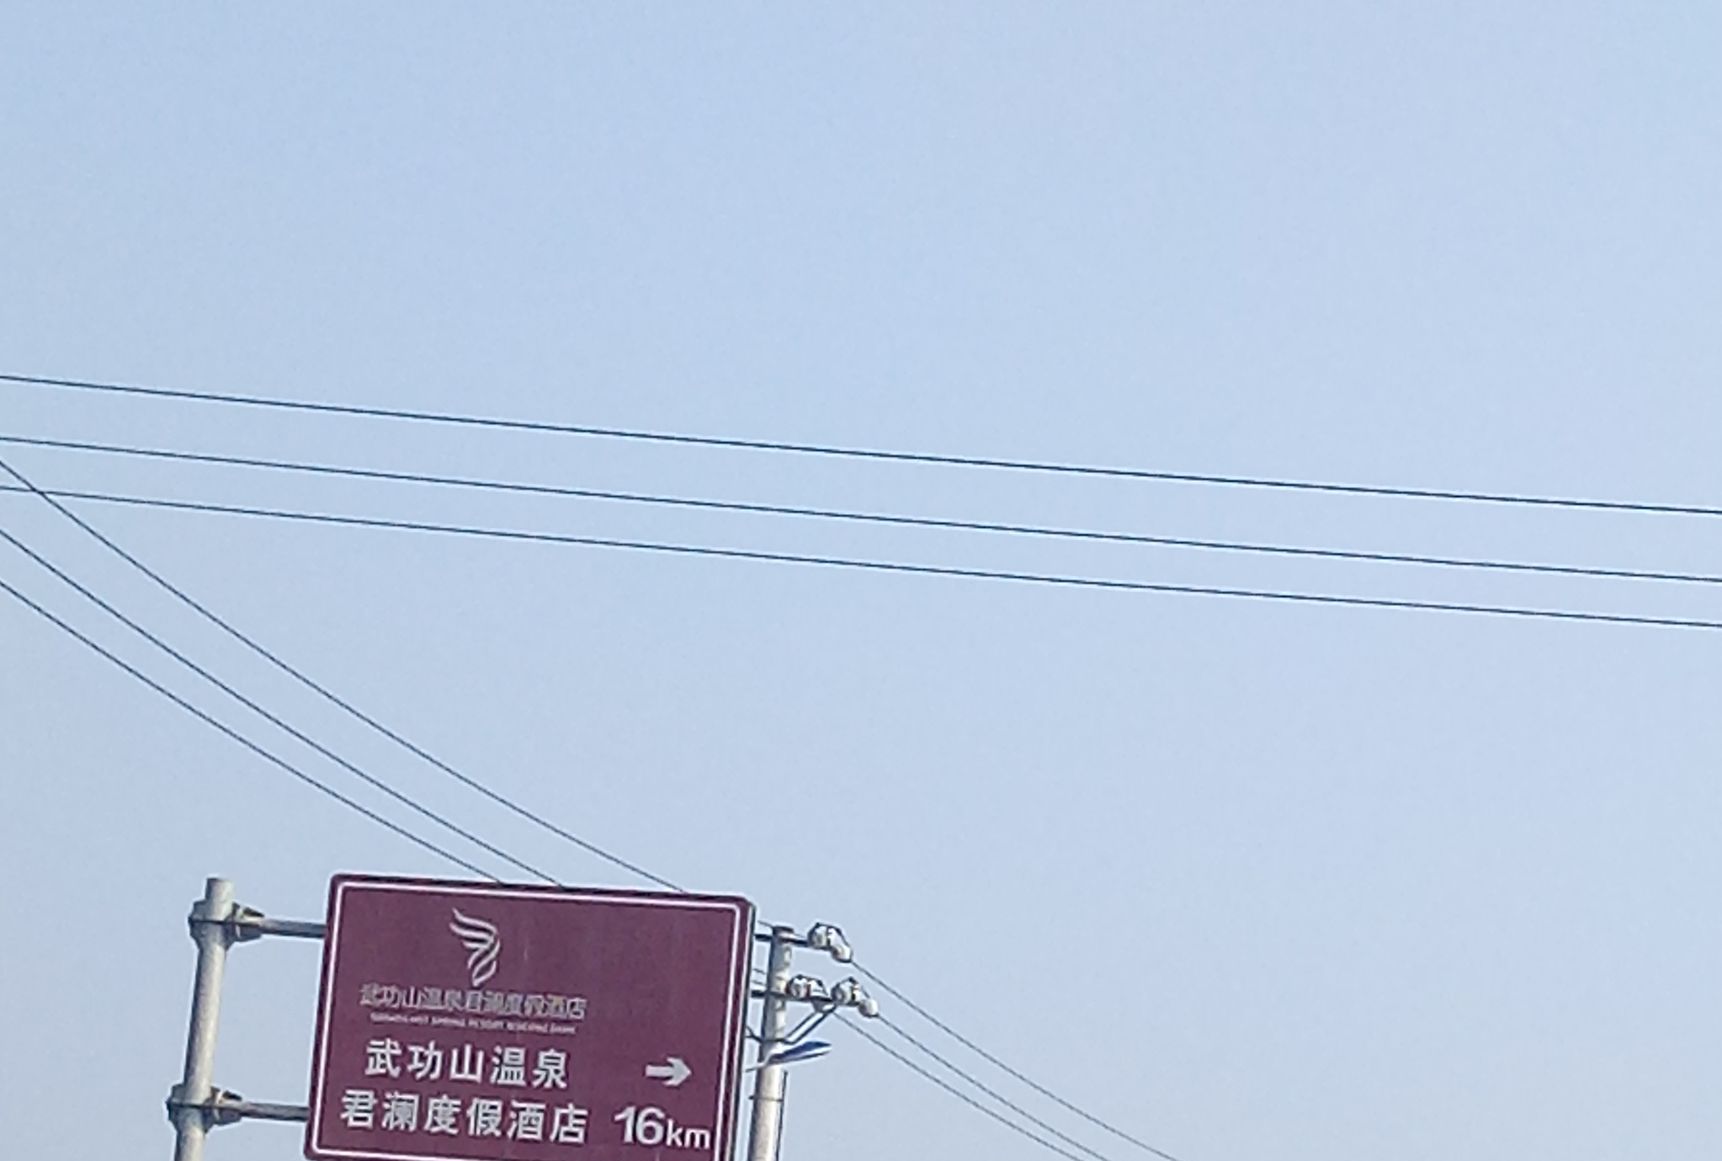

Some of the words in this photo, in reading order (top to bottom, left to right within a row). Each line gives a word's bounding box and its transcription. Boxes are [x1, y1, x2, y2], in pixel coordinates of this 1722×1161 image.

[365, 1038, 568, 1089] 武功山温泉
[340, 1089, 589, 1144] 君澜度假酒店
[614, 1105, 711, 1150] 16km
